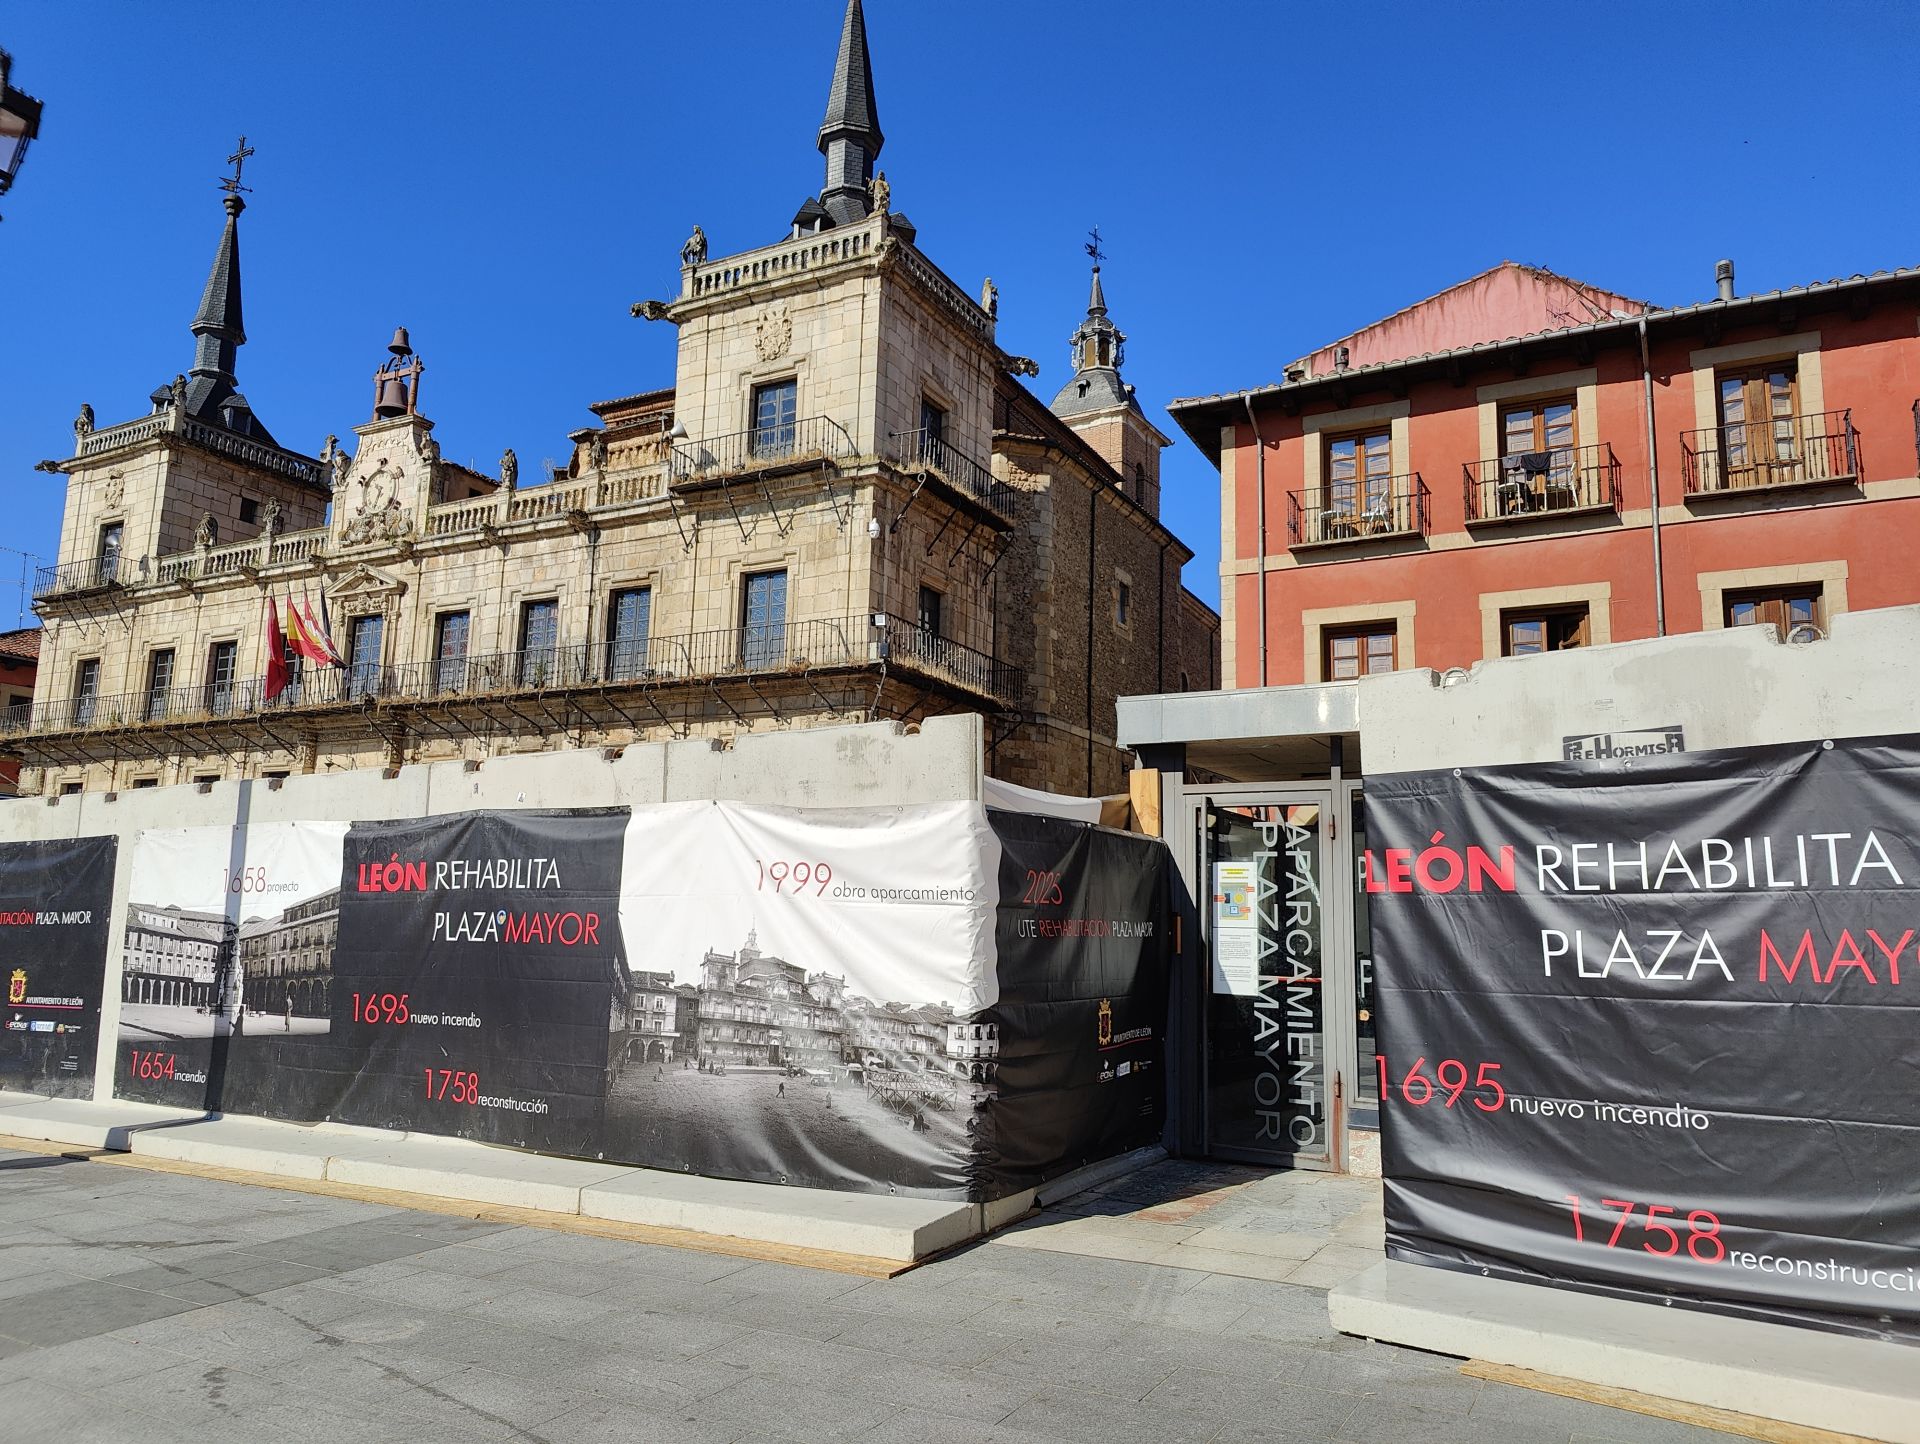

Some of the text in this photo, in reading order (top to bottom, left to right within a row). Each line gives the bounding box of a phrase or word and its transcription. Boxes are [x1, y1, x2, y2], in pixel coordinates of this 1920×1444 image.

[223, 866, 299, 895] 1658 proyecto
[358, 853, 561, 892] LEÓN REHABILITA
[755, 859, 976, 903] 1999 obra aparcamiento
[1364, 830, 1905, 893] LEÓN REHABILITA
[0, 909, 92, 925] ITACIÓN PLAZA MAYOR
[432, 911, 600, 945] PLAZA MAYOR
[1018, 919, 1038, 938] UTE
[1112, 920, 1133, 938] PLAZA
[1540, 928, 1920, 985] PLAZA MAY
[1285, 821, 1316, 1146] APARCAMIENTO
[352, 993, 482, 1028] 1695 nuevo incendio
[132, 1051, 207, 1084] 1654 incendio
[1254, 975, 1281, 1140] MAYOR
[424, 1068, 549, 1115] 1758 reconstrucción
[1375, 1055, 1710, 1130] 1695 nuevo incendio
[1565, 1194, 1920, 1293] 1758 reconstrucci
